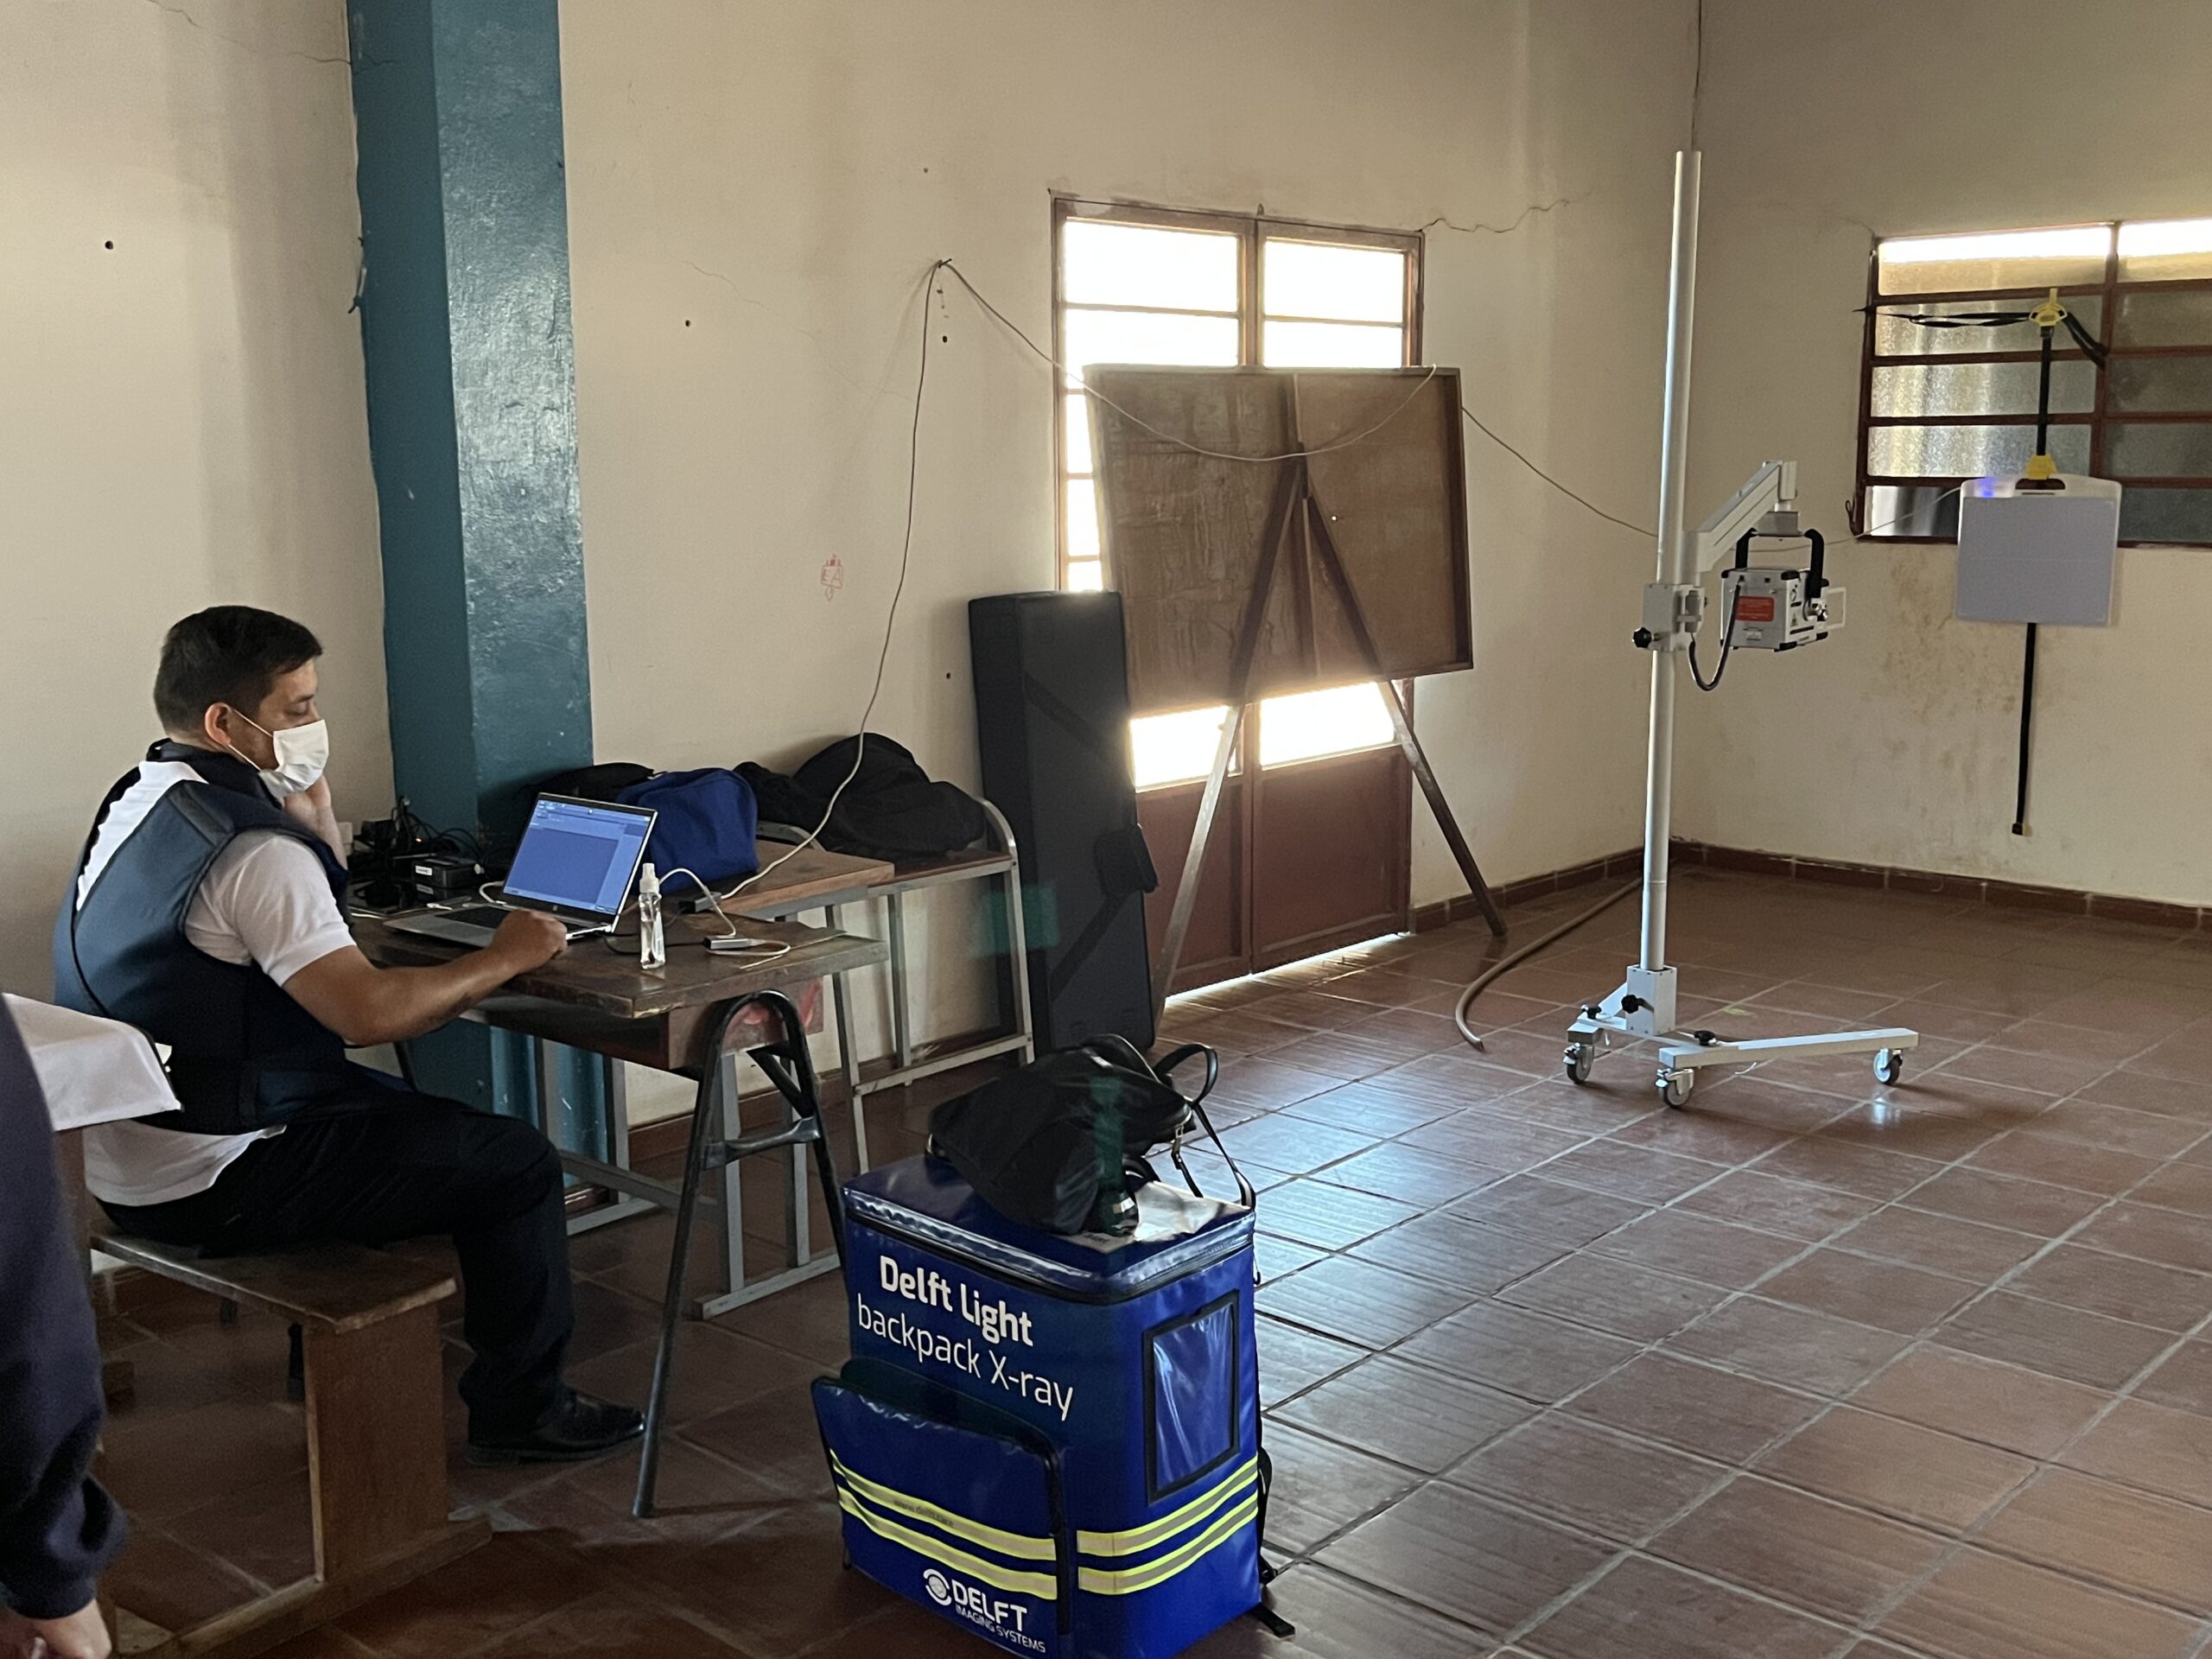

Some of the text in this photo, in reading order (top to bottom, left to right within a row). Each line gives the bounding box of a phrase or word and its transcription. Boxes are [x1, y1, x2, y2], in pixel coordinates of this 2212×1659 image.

[880, 1255, 1034, 1346] Delft Light
[857, 1294, 1074, 1421] backpack X-ray
[951, 1580, 1027, 1631] DELFT
[956, 1605, 1046, 1653] IMAGING SYSTEMS
